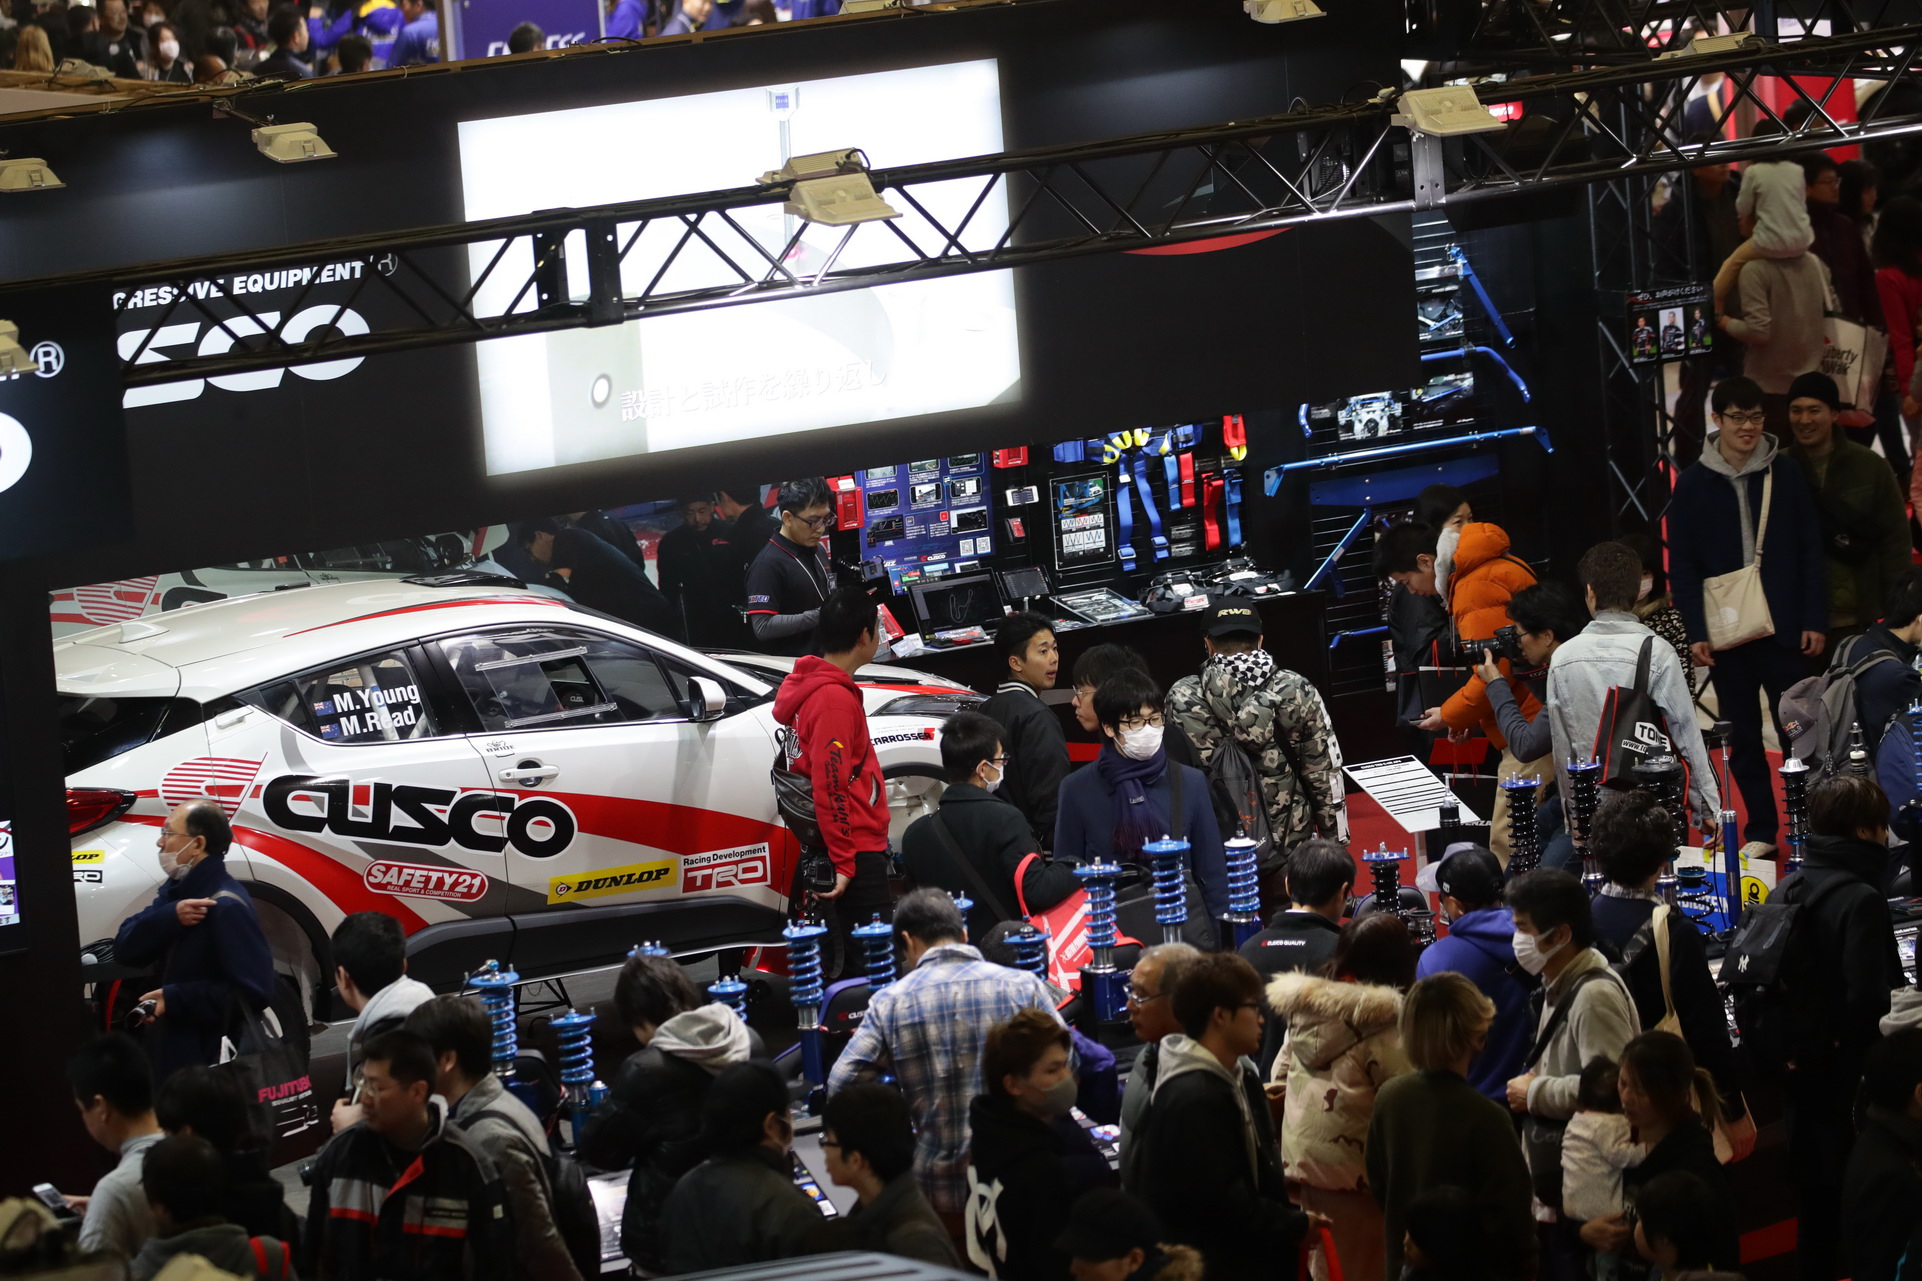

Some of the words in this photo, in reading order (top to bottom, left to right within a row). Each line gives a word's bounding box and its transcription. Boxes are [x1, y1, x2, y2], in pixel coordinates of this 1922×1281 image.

[233, 261, 365, 295] EQUIPMENT
[621, 362, 888, 423] 設計と試作を繰り返し
[1217, 608, 1252, 618] RWB
[333, 685, 421, 714] M.Young
[262, 774, 576, 859] CUSCO
[683, 854, 712, 867] Racing
[712, 845, 767, 862] Development
[368, 865, 482, 894] SAFETY21
[573, 867, 671, 893] DUNLOP
[687, 859, 764, 889] TRD
[387, 884, 403, 892] REAL
[402, 886, 420, 894] SPORT
[425, 889, 462, 898] COMPETITION
